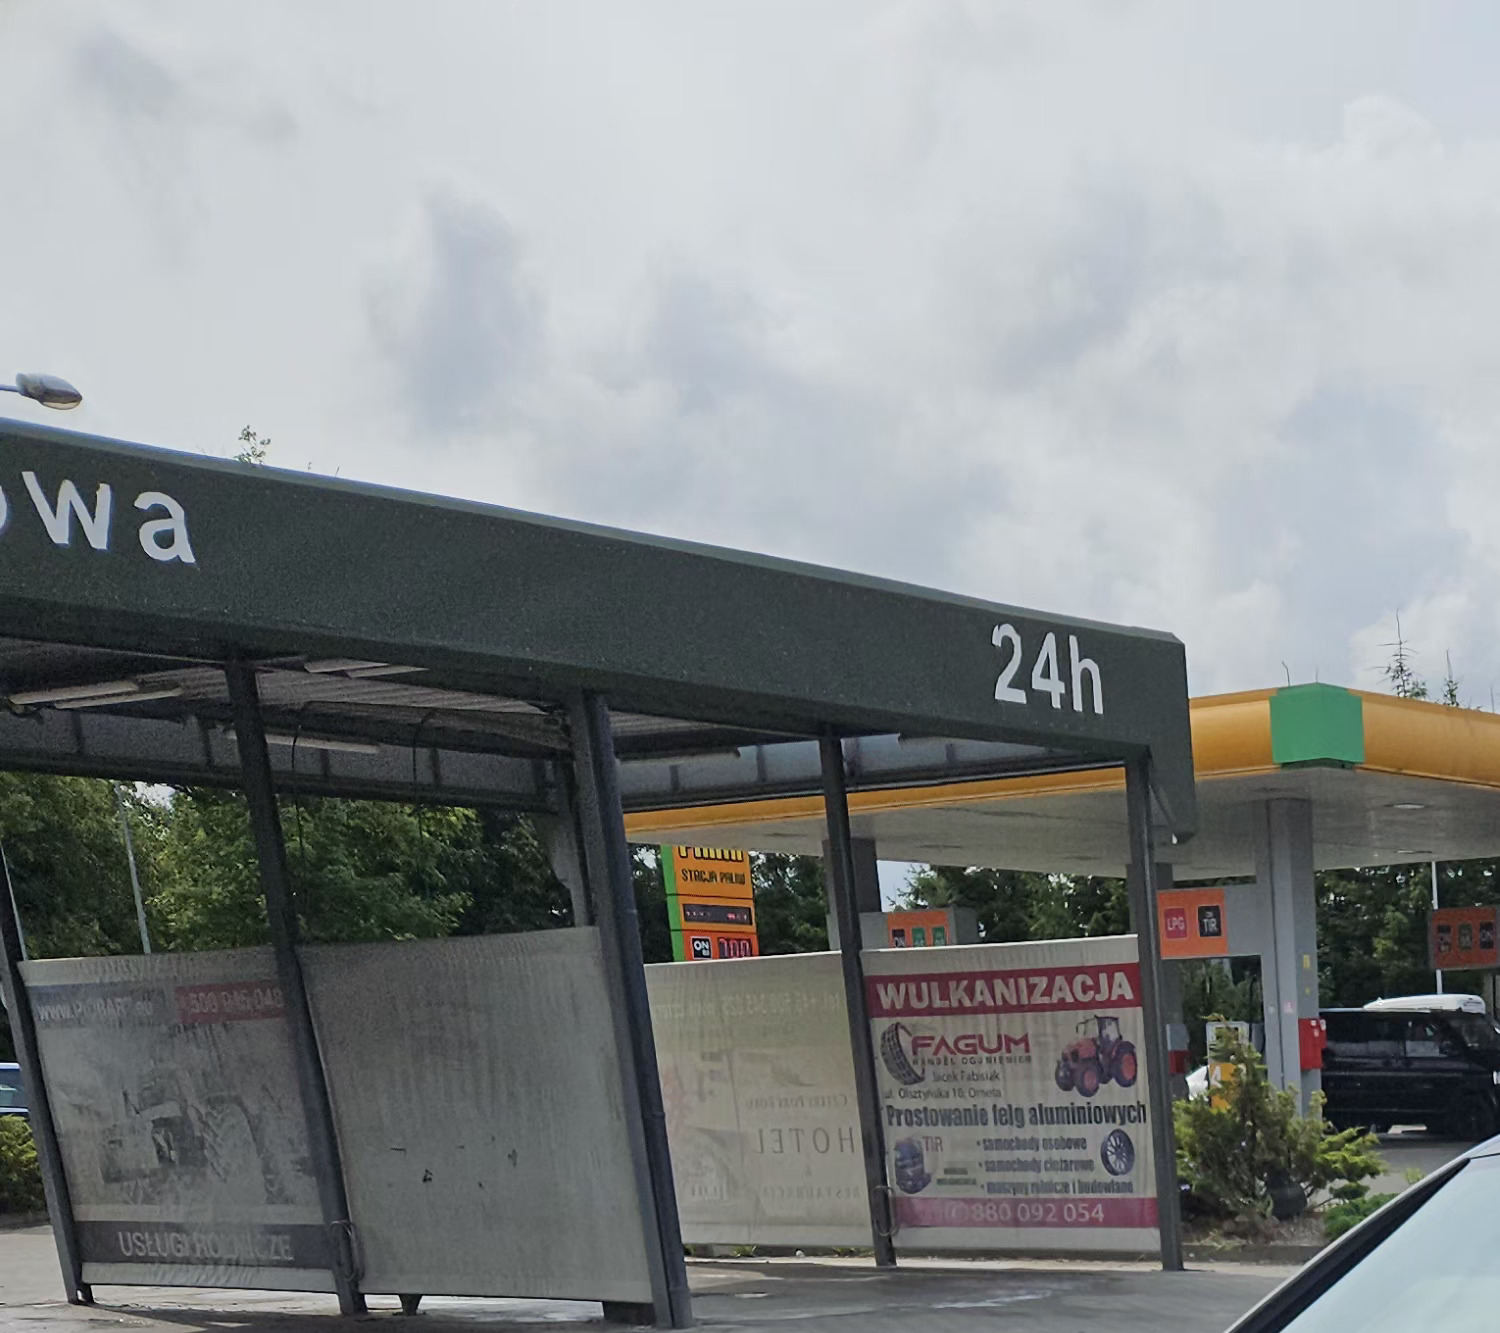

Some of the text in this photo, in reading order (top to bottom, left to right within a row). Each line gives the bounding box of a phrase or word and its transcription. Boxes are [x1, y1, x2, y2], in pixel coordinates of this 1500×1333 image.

[0, 471, 196, 563] wa
[992, 623, 1103, 714] 24h
[877, 971, 1134, 1010] WULKANIZACJA
[911, 1032, 1031, 1056] FAGUM
[886, 1100, 1147, 1128] Prostowanie felg aluminiowych
[982, 1136, 1039, 1152] samochody
[1016, 1203, 1058, 1222] 092
[1063, 1203, 1105, 1222] 054
